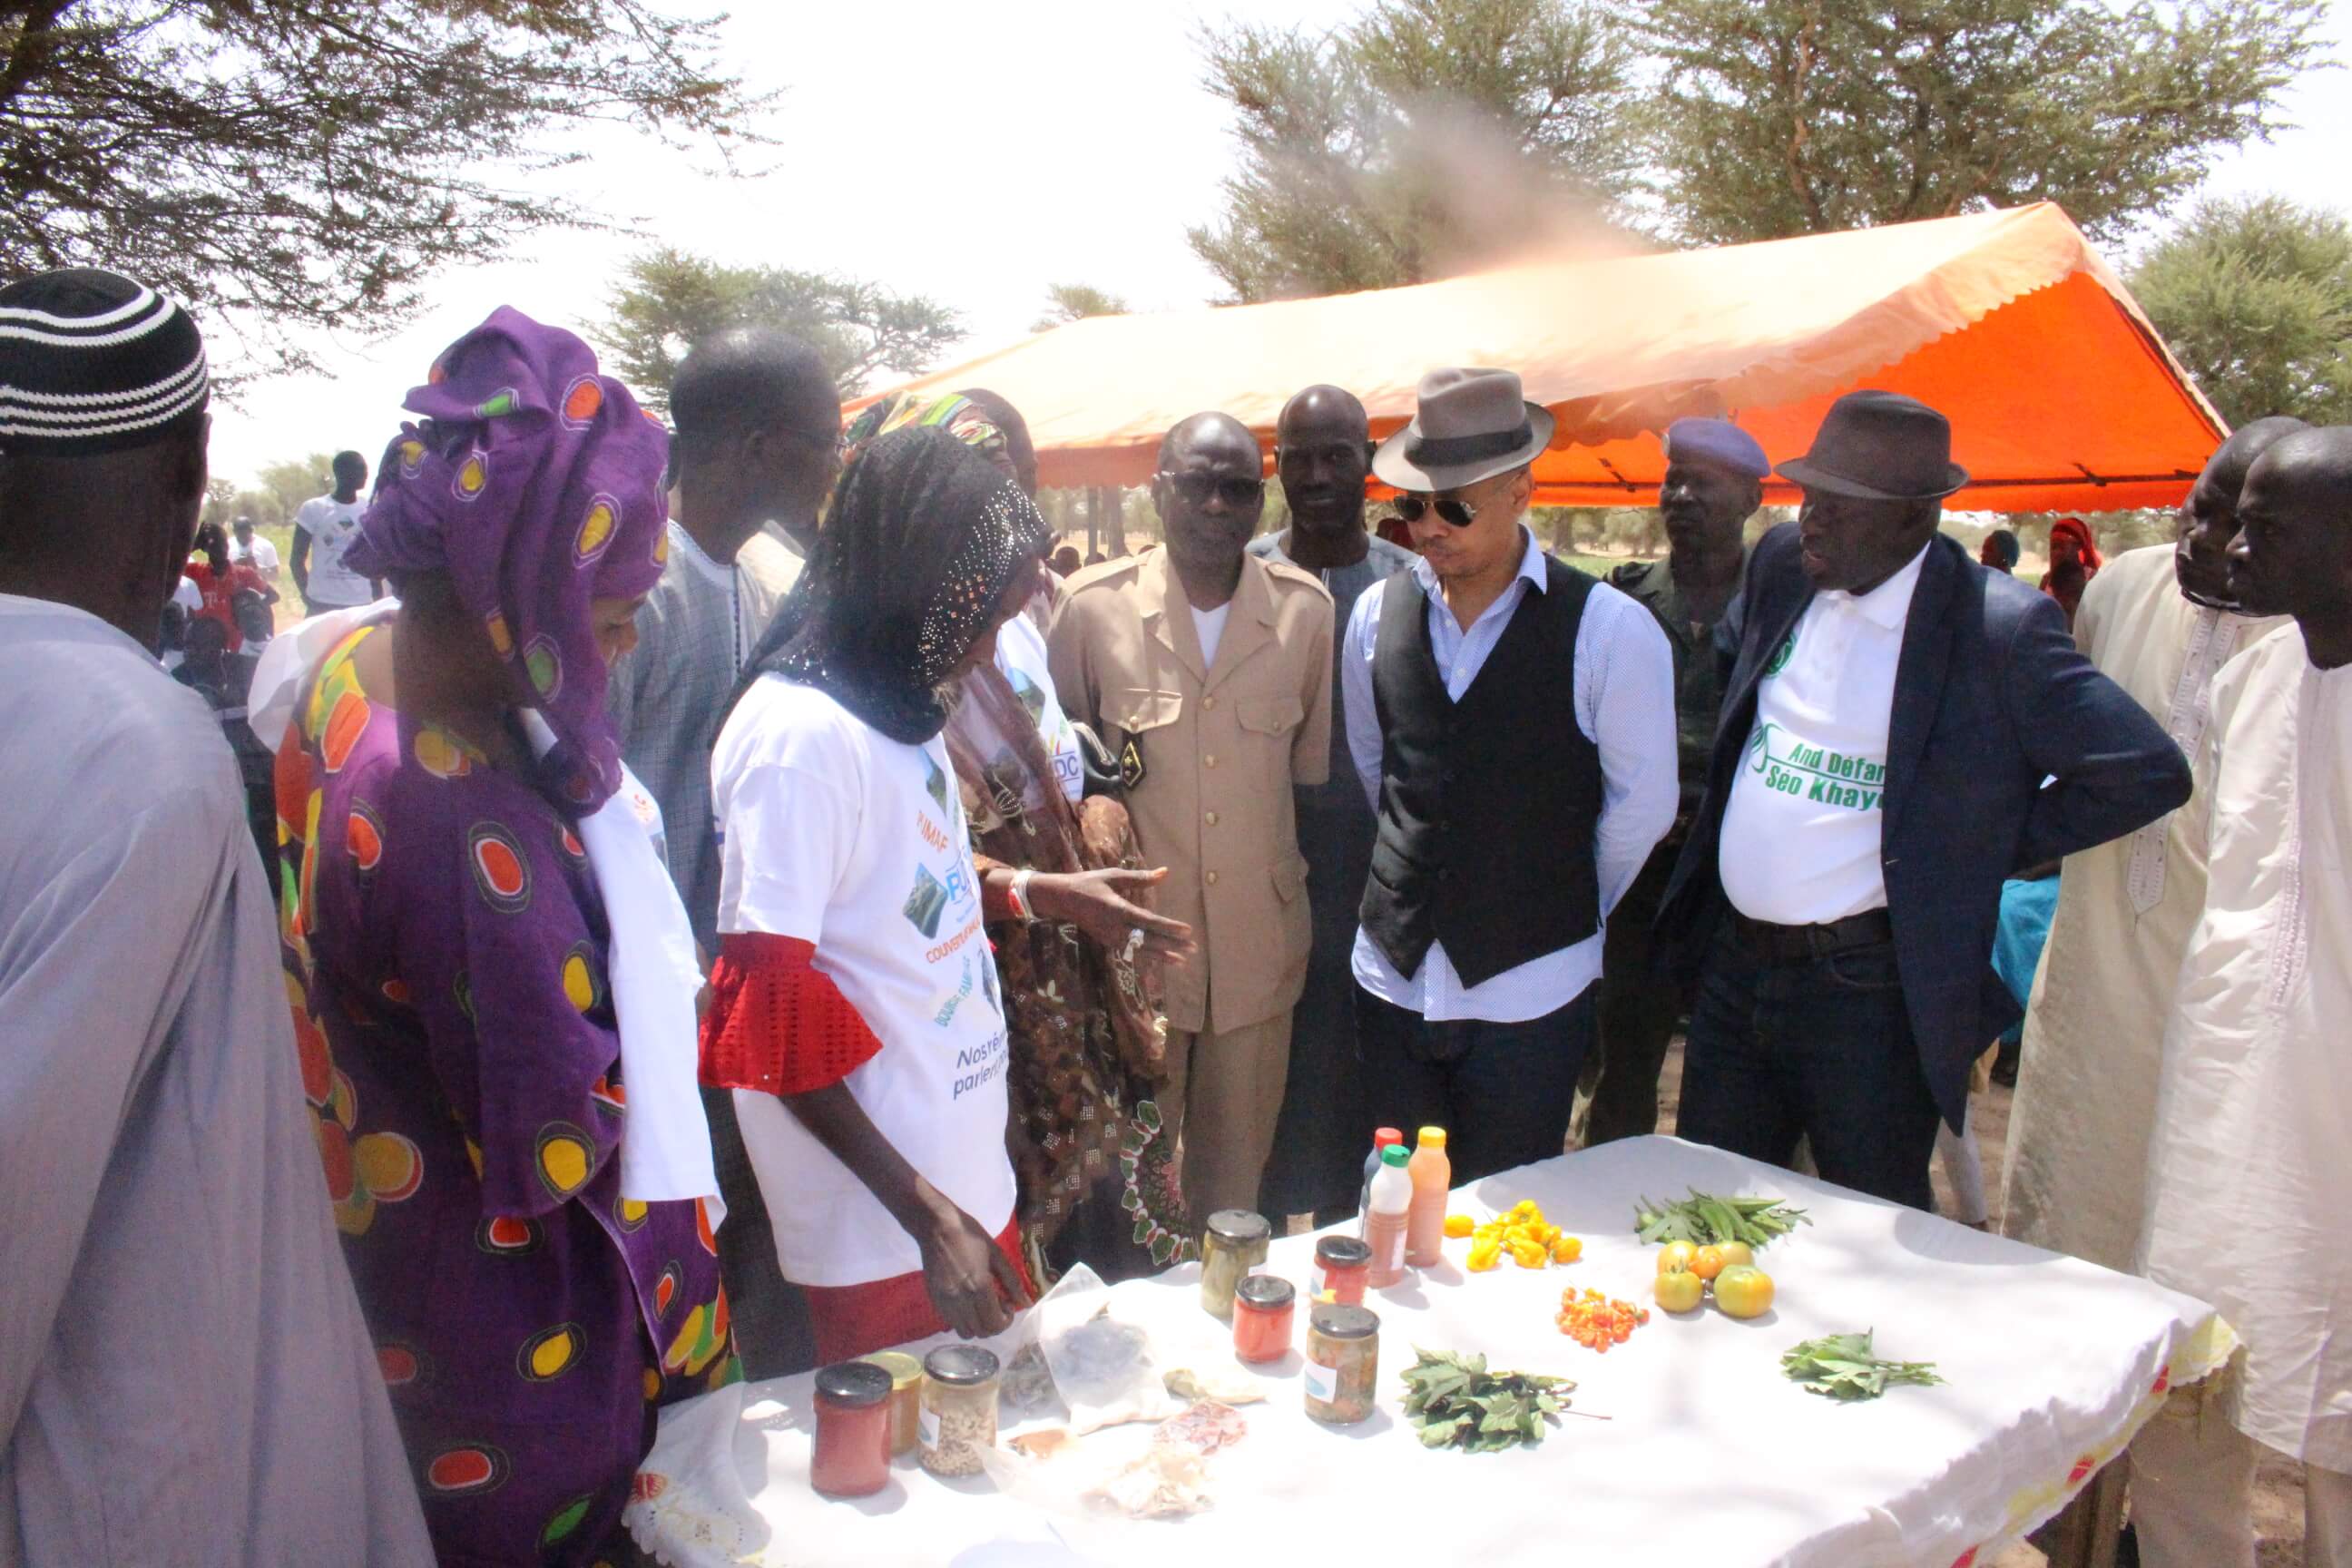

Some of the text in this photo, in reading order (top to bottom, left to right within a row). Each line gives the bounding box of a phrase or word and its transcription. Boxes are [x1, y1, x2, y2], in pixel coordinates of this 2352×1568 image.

[1788, 743, 1886, 779] And Défar
[1765, 764, 1802, 795] Séo
[957, 1044, 987, 1070] Nos
